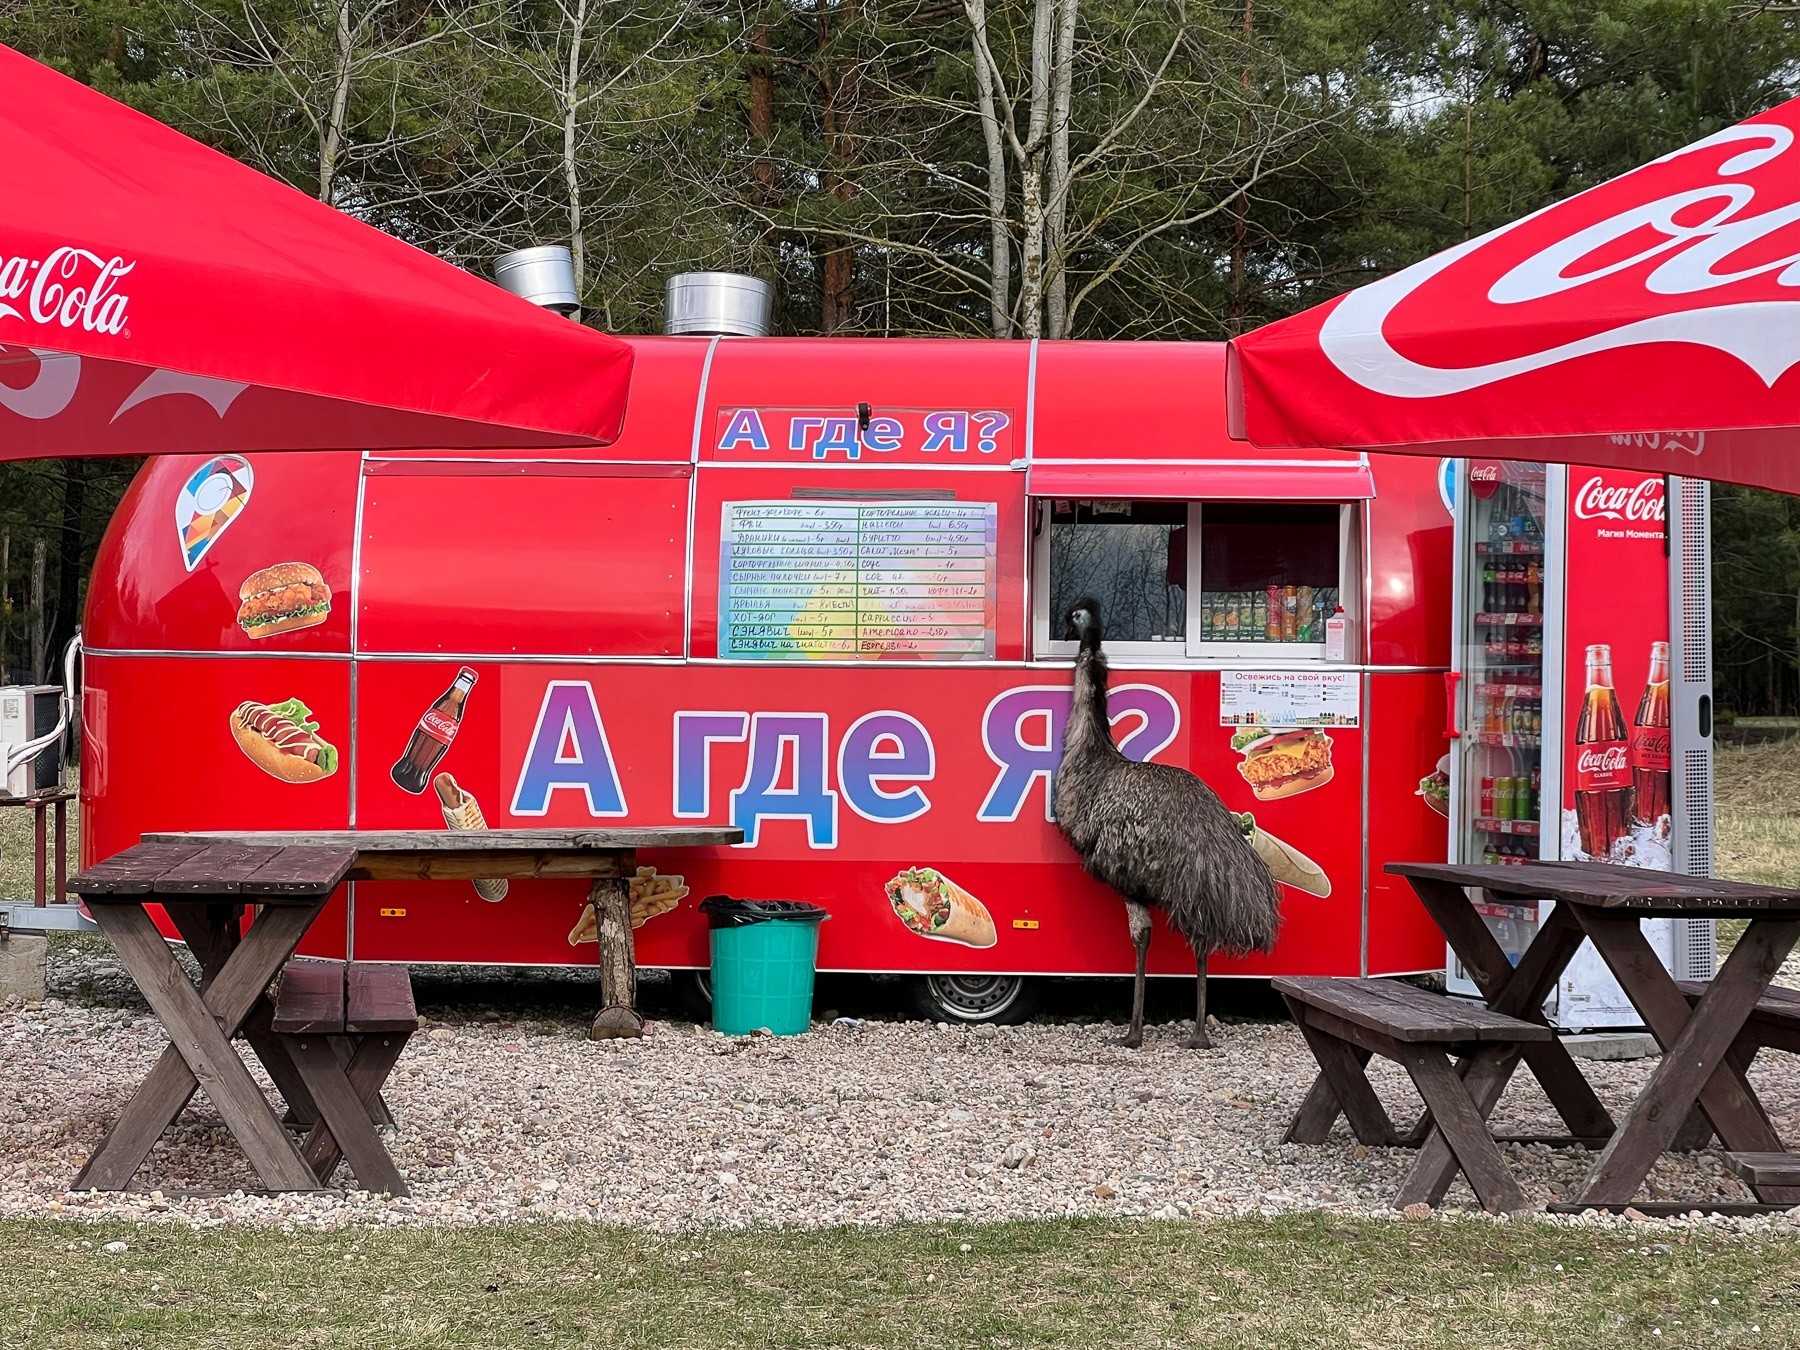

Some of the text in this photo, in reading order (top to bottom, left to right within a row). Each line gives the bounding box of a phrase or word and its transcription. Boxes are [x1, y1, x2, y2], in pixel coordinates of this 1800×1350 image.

[1319, 124, 1800, 388] Coc
[718, 408, 1010, 460] А где Я?
[1575, 476, 1665, 521] Coca-Col
[1597, 529, 1625, 538] Магия
[1235, 673, 1281, 681] Освежись
[1297, 673, 1319, 681] свой
[1322, 674, 1345, 682] вкус!
[424, 712, 458, 736] Coca-Cola
[510, 680, 628, 817] А
[673, 710, 936, 849] где
[1577, 747, 1628, 773] Coca-Cola
